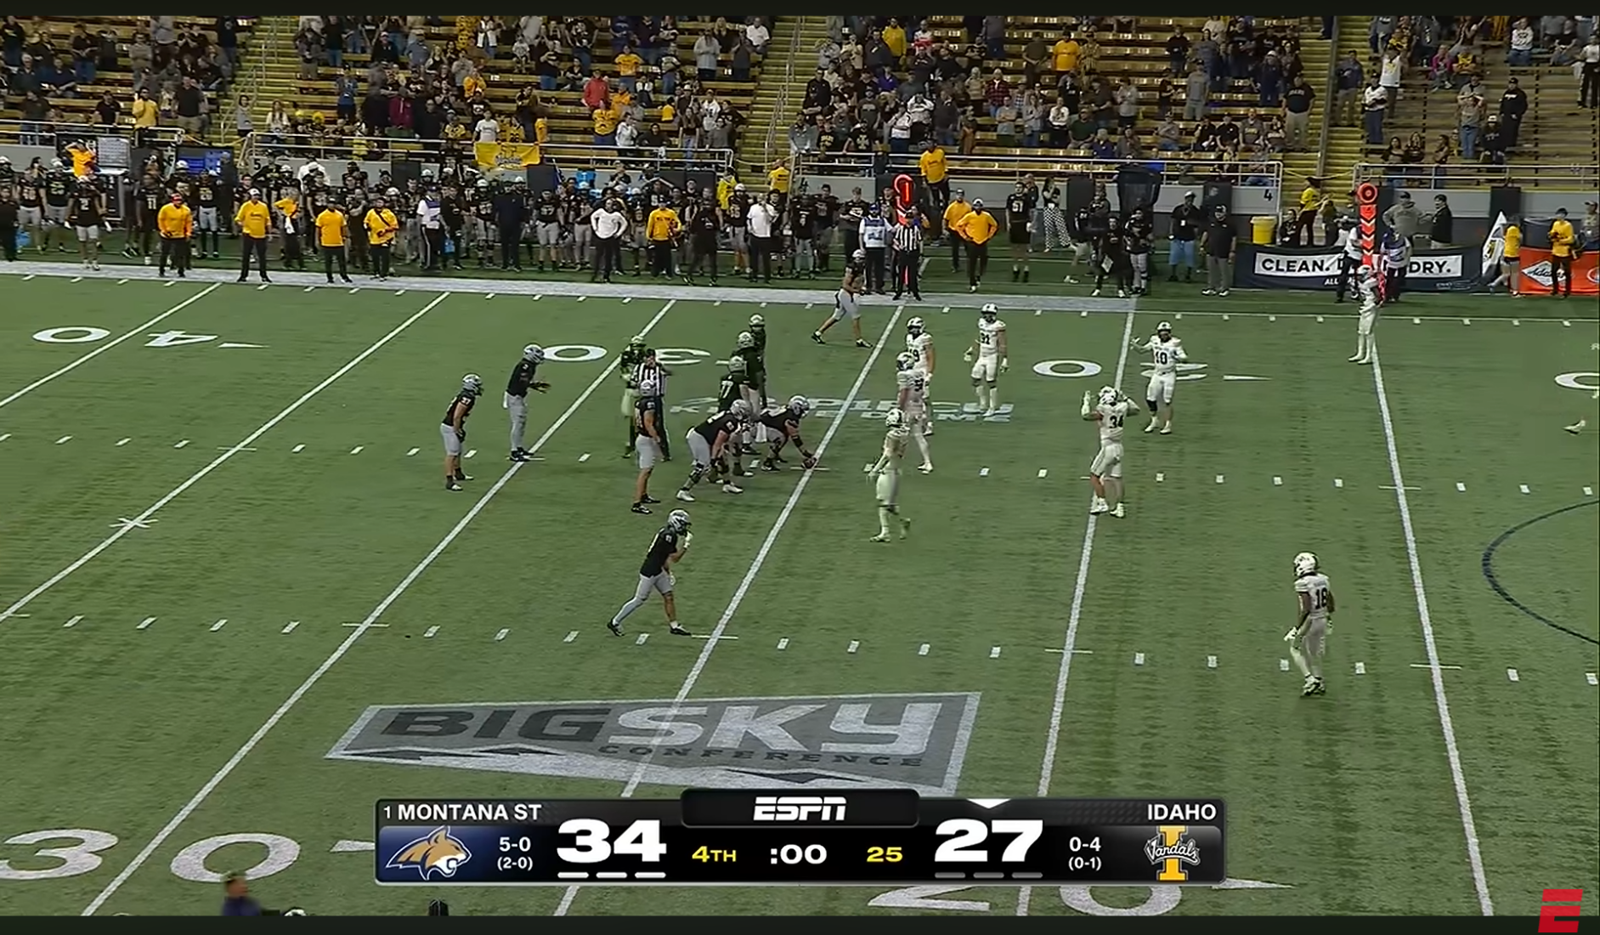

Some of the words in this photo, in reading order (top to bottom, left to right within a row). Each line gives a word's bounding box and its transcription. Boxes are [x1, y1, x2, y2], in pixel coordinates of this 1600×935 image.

[253, 158, 262, 171] 5
[1262, 188, 1273, 202] 4
[1262, 260, 1331, 273] CLEAN.
[1155, 351, 1168, 365] 10
[1315, 587, 1328, 610] 18
[380, 707, 612, 742] BIG
[608, 702, 942, 756] SKY
[598, 745, 922, 767] CONFERENCE
